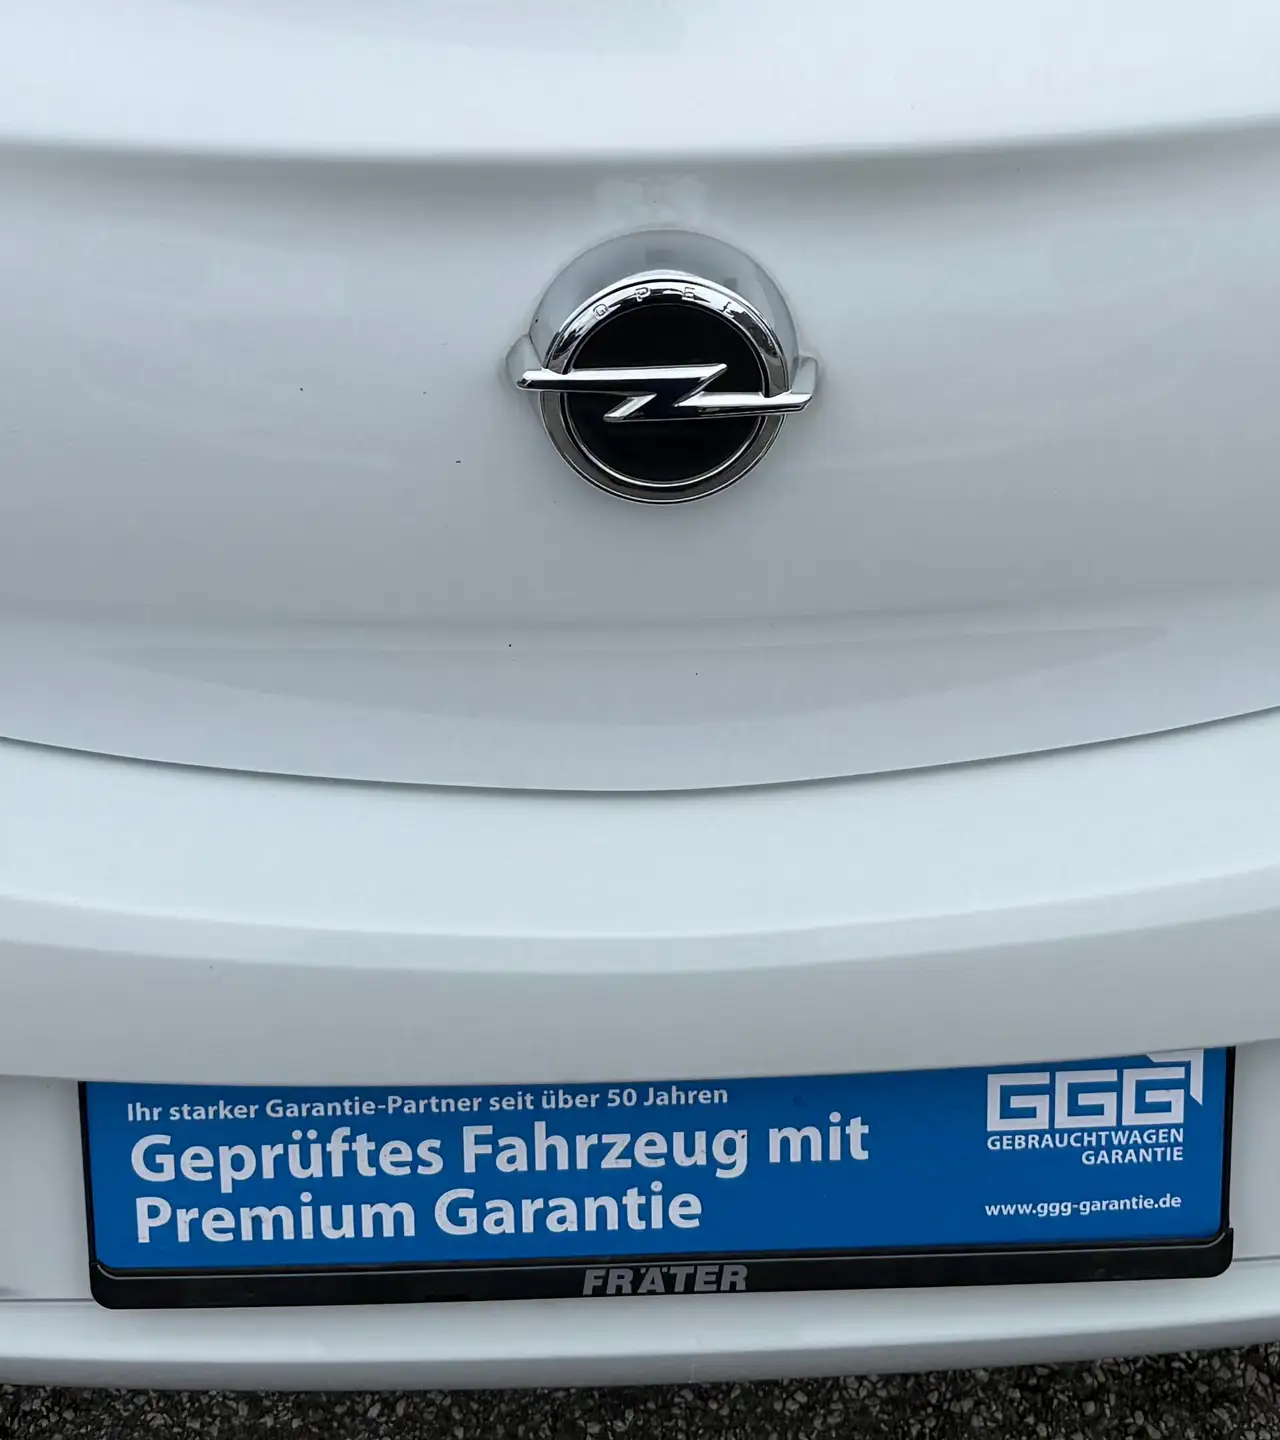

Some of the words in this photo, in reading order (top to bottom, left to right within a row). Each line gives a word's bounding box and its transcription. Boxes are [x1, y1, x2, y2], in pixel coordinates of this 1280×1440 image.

[593, 286, 736, 321] OPEL
[127, 1102, 162, 1122] Ihr
[169, 1100, 259, 1121] starker
[266, 1095, 482, 1118] Garantie-Partner
[489, 1091, 535, 1111] seit
[541, 1089, 600, 1110] über
[607, 1088, 637, 1107] 50
[643, 1086, 729, 1106] Jahren
[987, 1066, 1186, 1132] GGG
[130, 1126, 444, 1194] Geprüftes
[462, 1121, 749, 1179] Fahrzeug
[769, 1111, 870, 1164] mit
[986, 1128, 1184, 1150] GEBRAUCHTWAGEN
[1081, 1146, 1184, 1165] GARANTIE
[135, 1191, 416, 1243] Premium
[434, 1180, 703, 1236] Garantie
[985, 1193, 1182, 1217] www.ggg-garantie.de
[582, 1264, 748, 1296] FRÄTER
